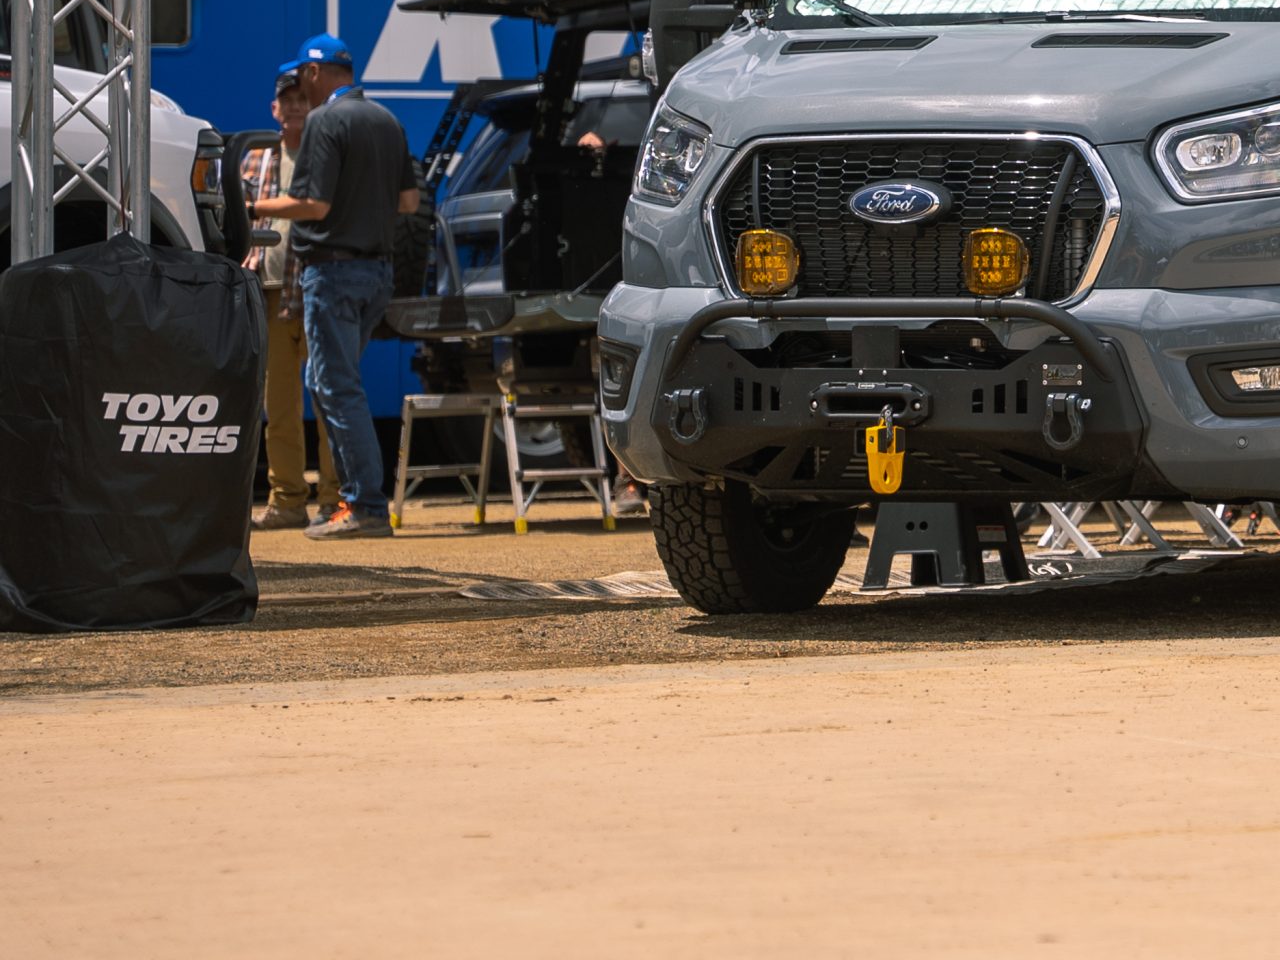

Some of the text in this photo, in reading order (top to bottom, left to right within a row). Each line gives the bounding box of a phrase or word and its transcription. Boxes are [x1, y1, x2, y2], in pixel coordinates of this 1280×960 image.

[866, 190, 917, 213] Ford
[102, 392, 219, 422] TOYO
[119, 424, 241, 453] TIRES
